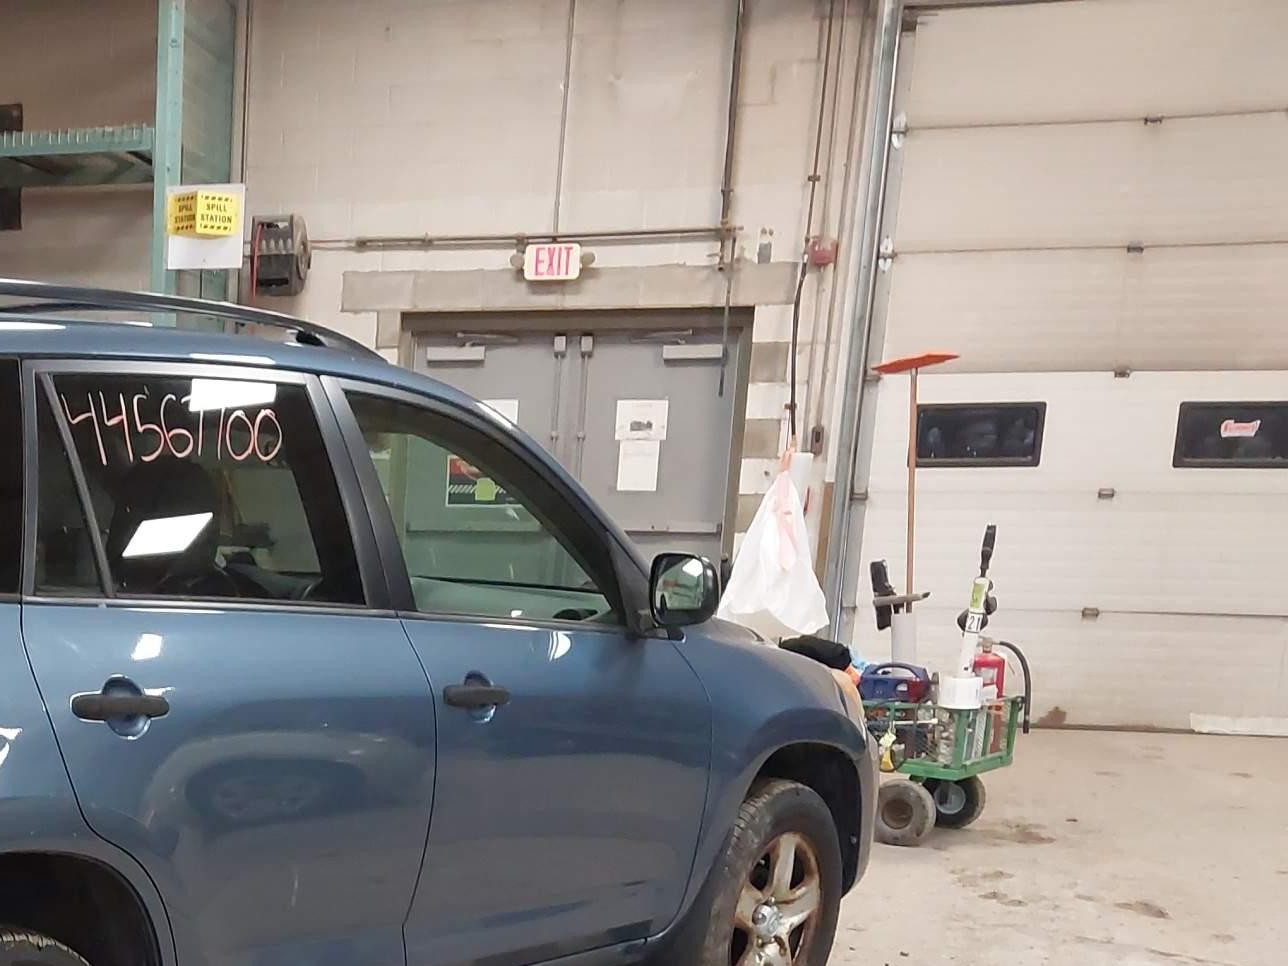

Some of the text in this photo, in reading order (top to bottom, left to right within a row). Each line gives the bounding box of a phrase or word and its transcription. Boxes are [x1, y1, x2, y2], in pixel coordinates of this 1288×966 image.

[205, 203, 228, 213] SPILL
[200, 213, 233, 224] STATION
[534, 246, 573, 277] EXIT
[967, 615, 981, 631] 21
